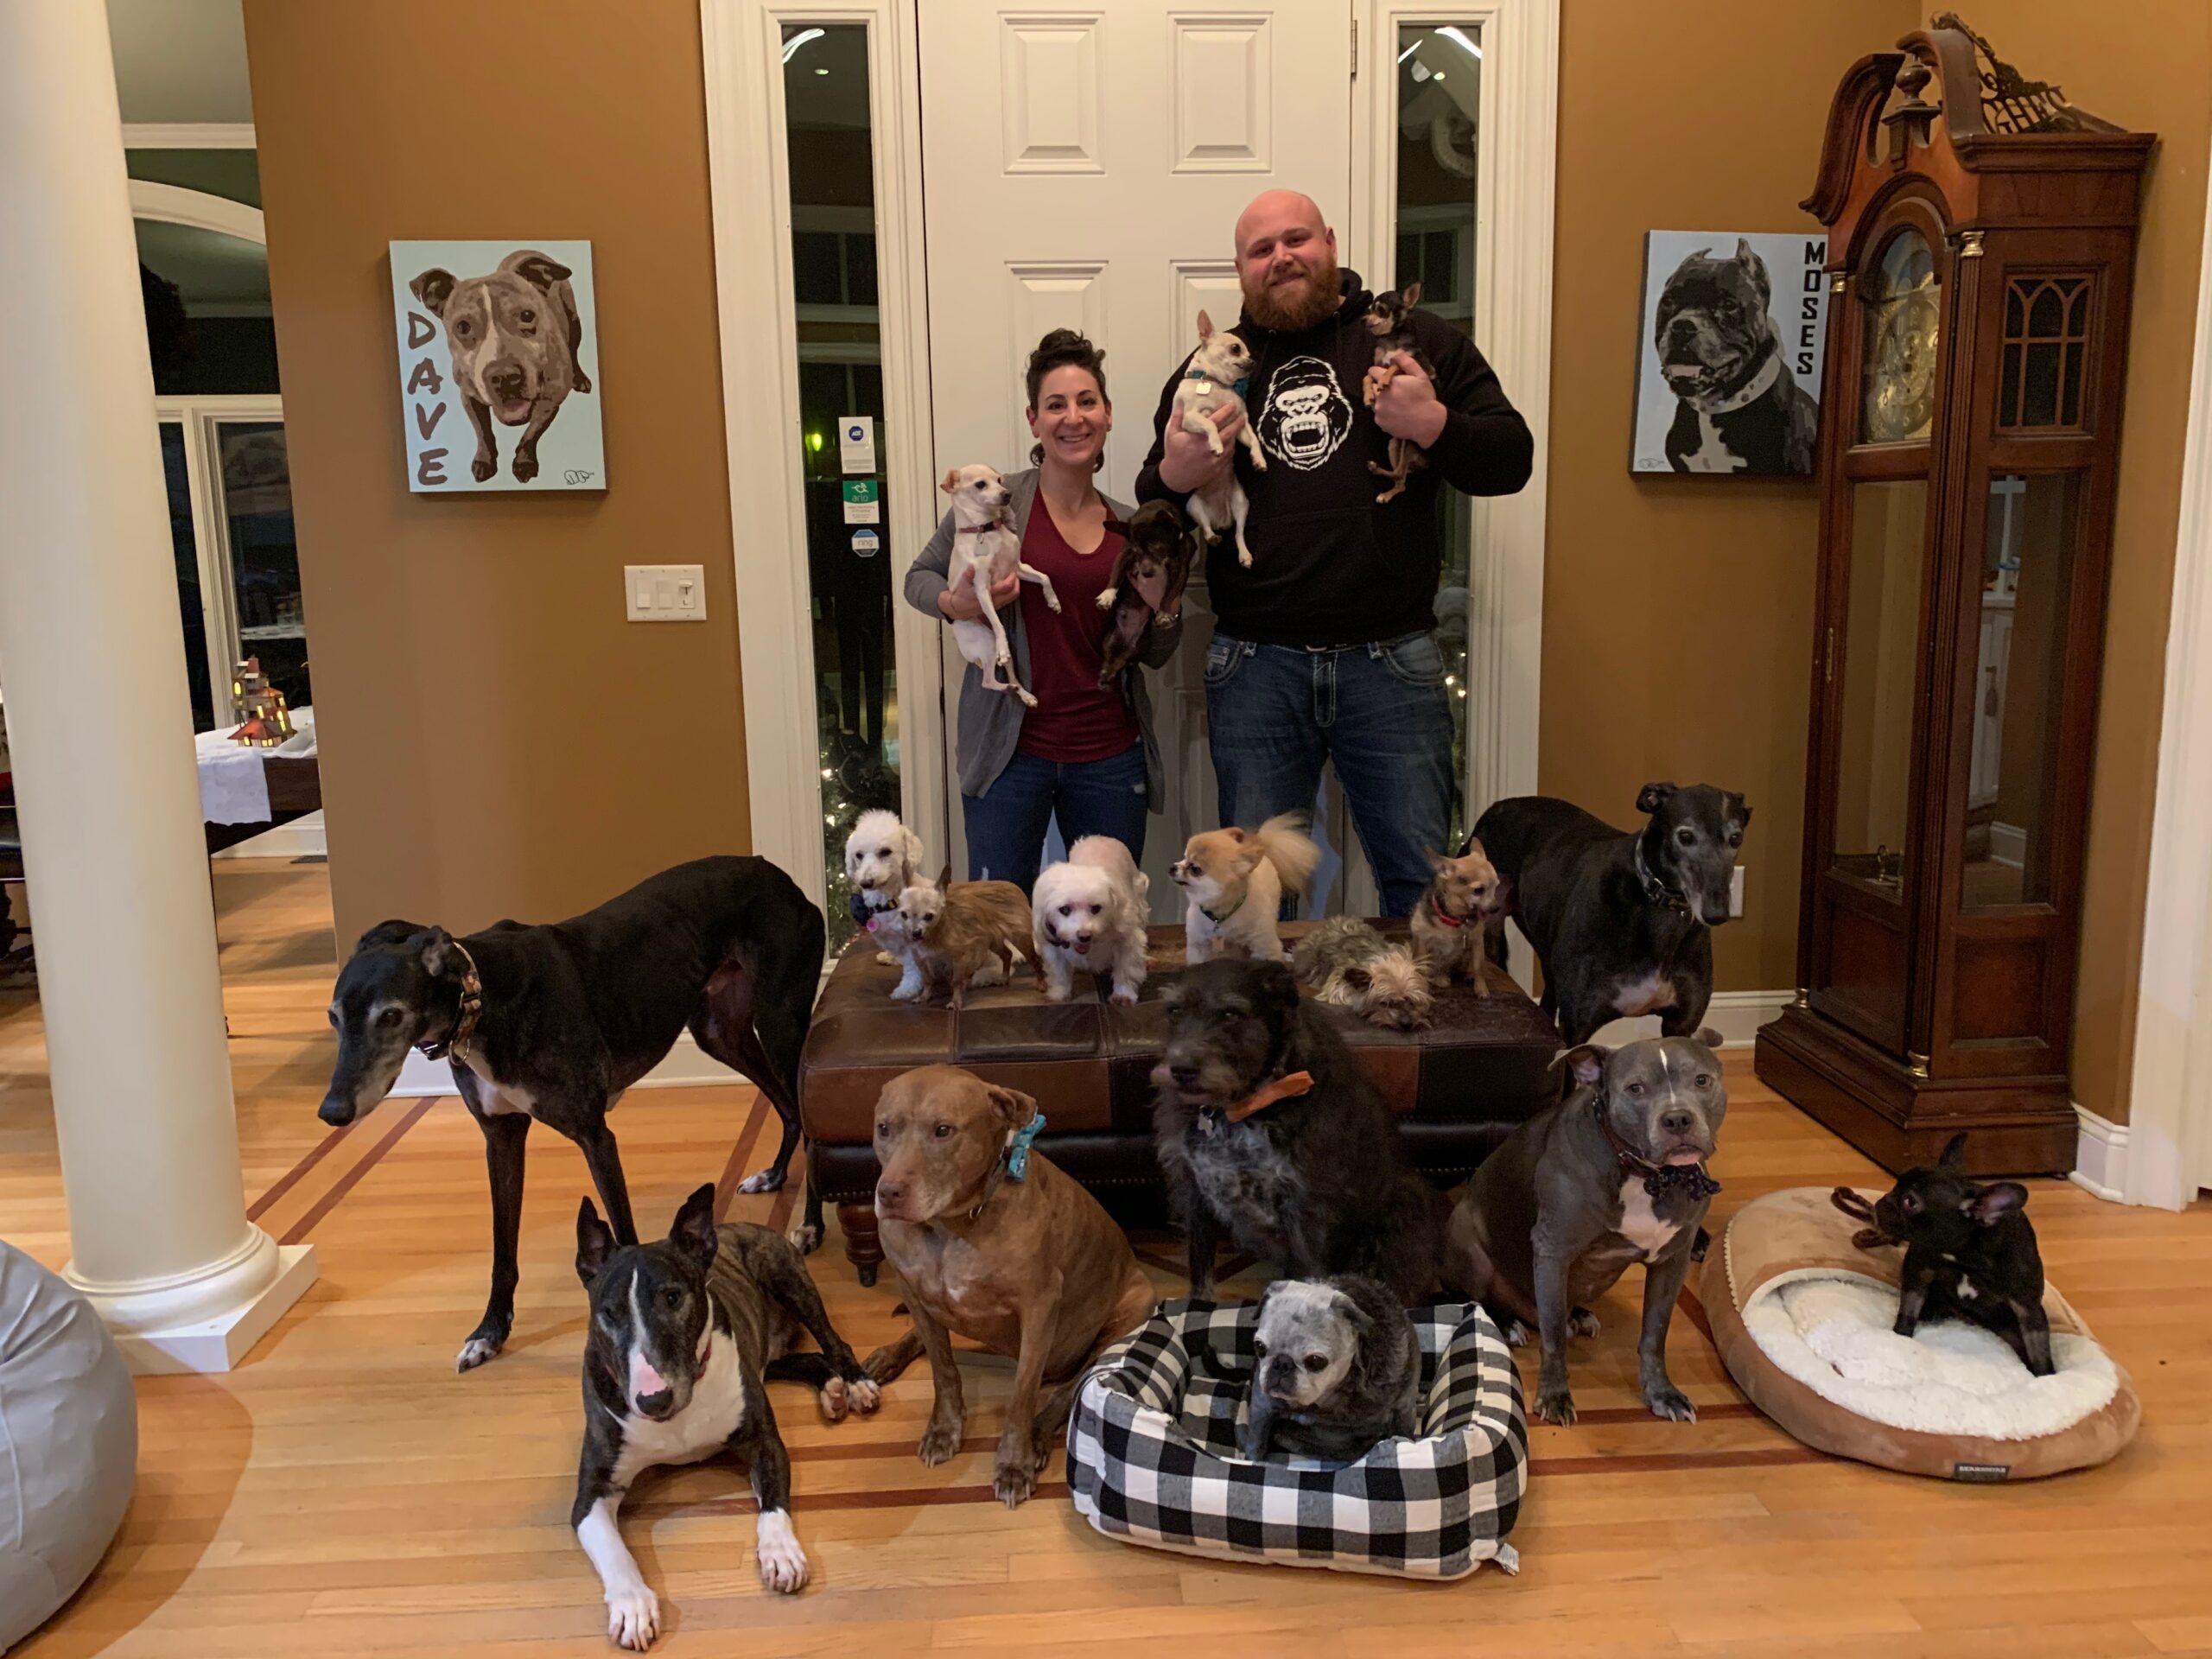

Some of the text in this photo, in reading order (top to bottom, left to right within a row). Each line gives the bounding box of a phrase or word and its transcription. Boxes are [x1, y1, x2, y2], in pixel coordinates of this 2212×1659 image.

[1796, 241, 1826, 375] MOSES
[406, 311, 449, 486] DAVE
[851, 493, 869, 503] arlo
[857, 539, 874, 548] ring
